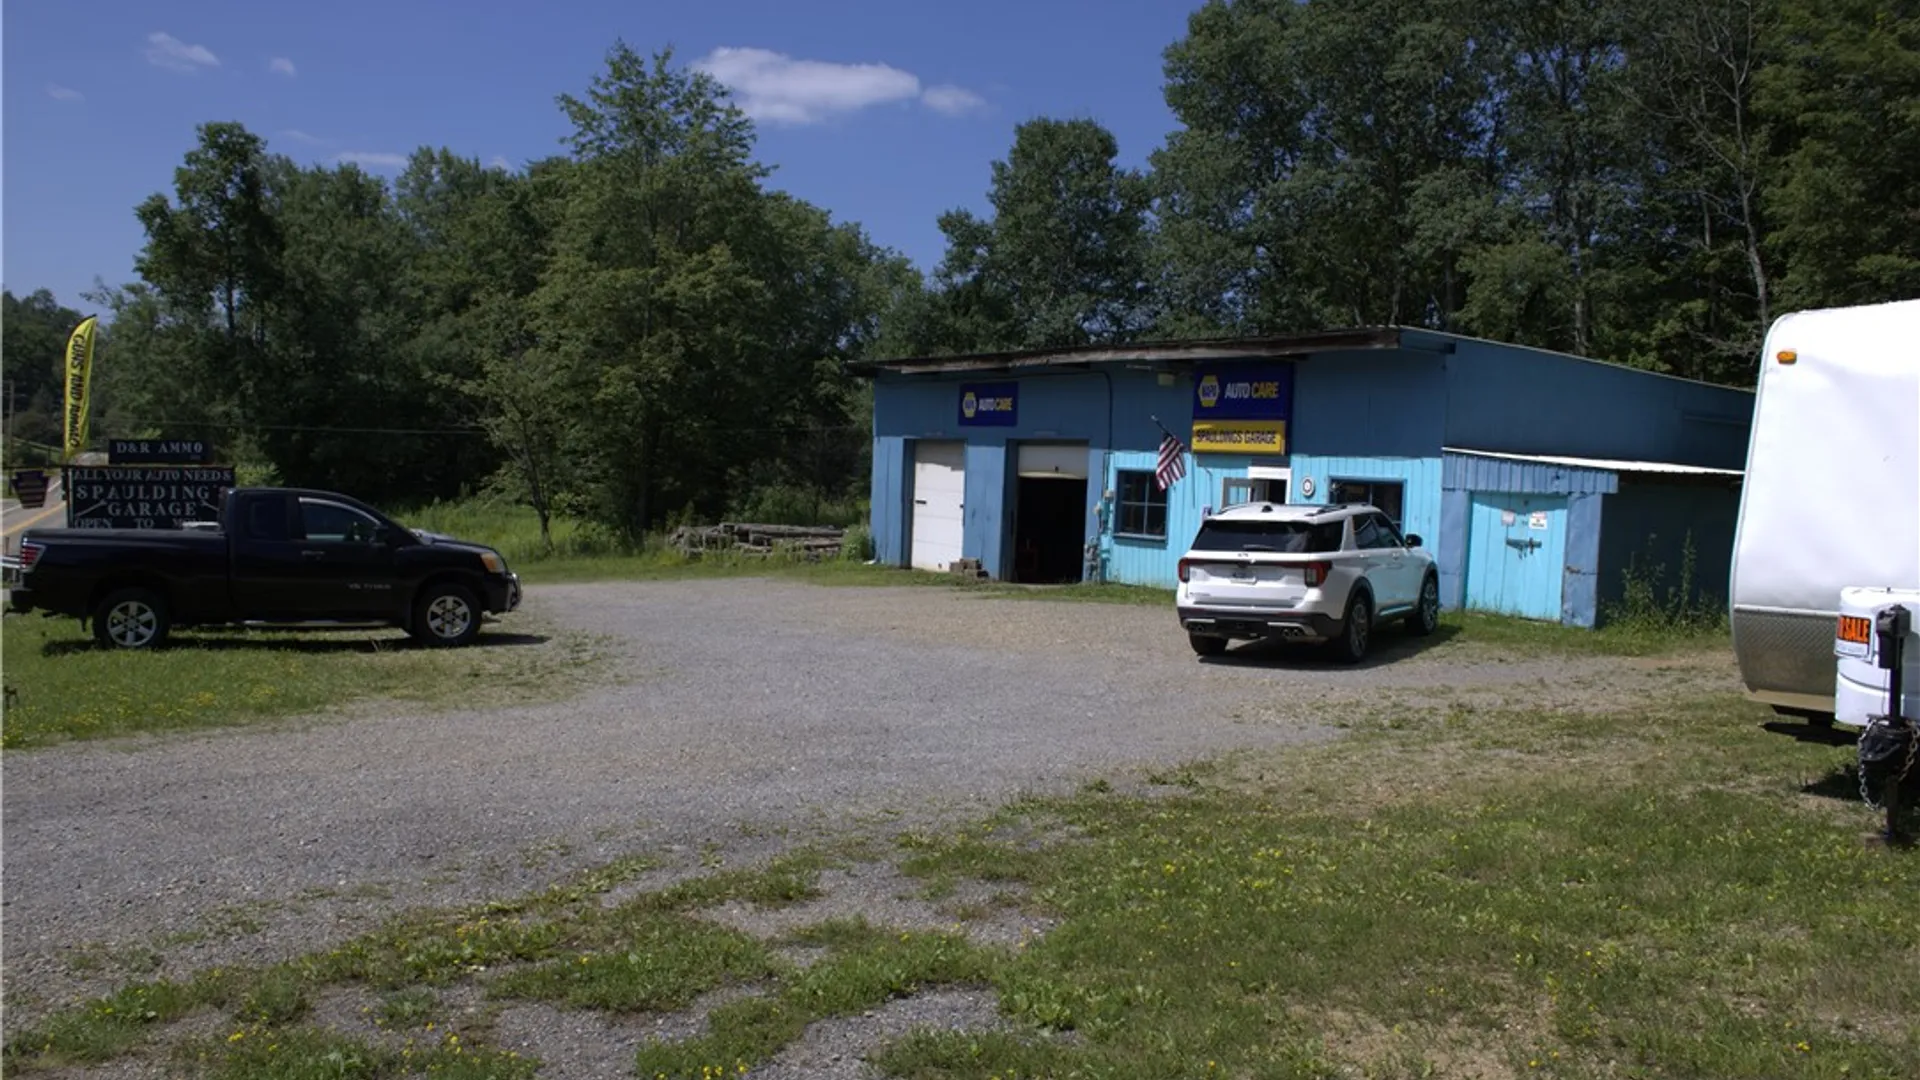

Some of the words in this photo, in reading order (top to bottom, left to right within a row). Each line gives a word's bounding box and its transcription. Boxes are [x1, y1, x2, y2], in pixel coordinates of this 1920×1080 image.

[71, 333, 85, 370] GUNS
[70, 373, 84, 401] AND
[1224, 382, 1251, 399] AUTO
[1251, 381, 1279, 399] CARE
[978, 398, 994, 411] AUTO
[995, 397, 1013, 411] CARE
[1195, 429, 1243, 444] SPAULDINGS
[1244, 430, 1277, 445] GARAGE
[116, 441, 150, 453] D&R
[158, 441, 203, 453] AMMO
[74, 469, 103, 481] ALL
[103, 469, 142, 481] YOUR
[145, 469, 180, 481] AUTO
[184, 469, 232, 481] NEEDS
[107, 501, 197, 516] GARAGE
[74, 517, 113, 529] OPEN
[134, 517, 154, 529] TO
